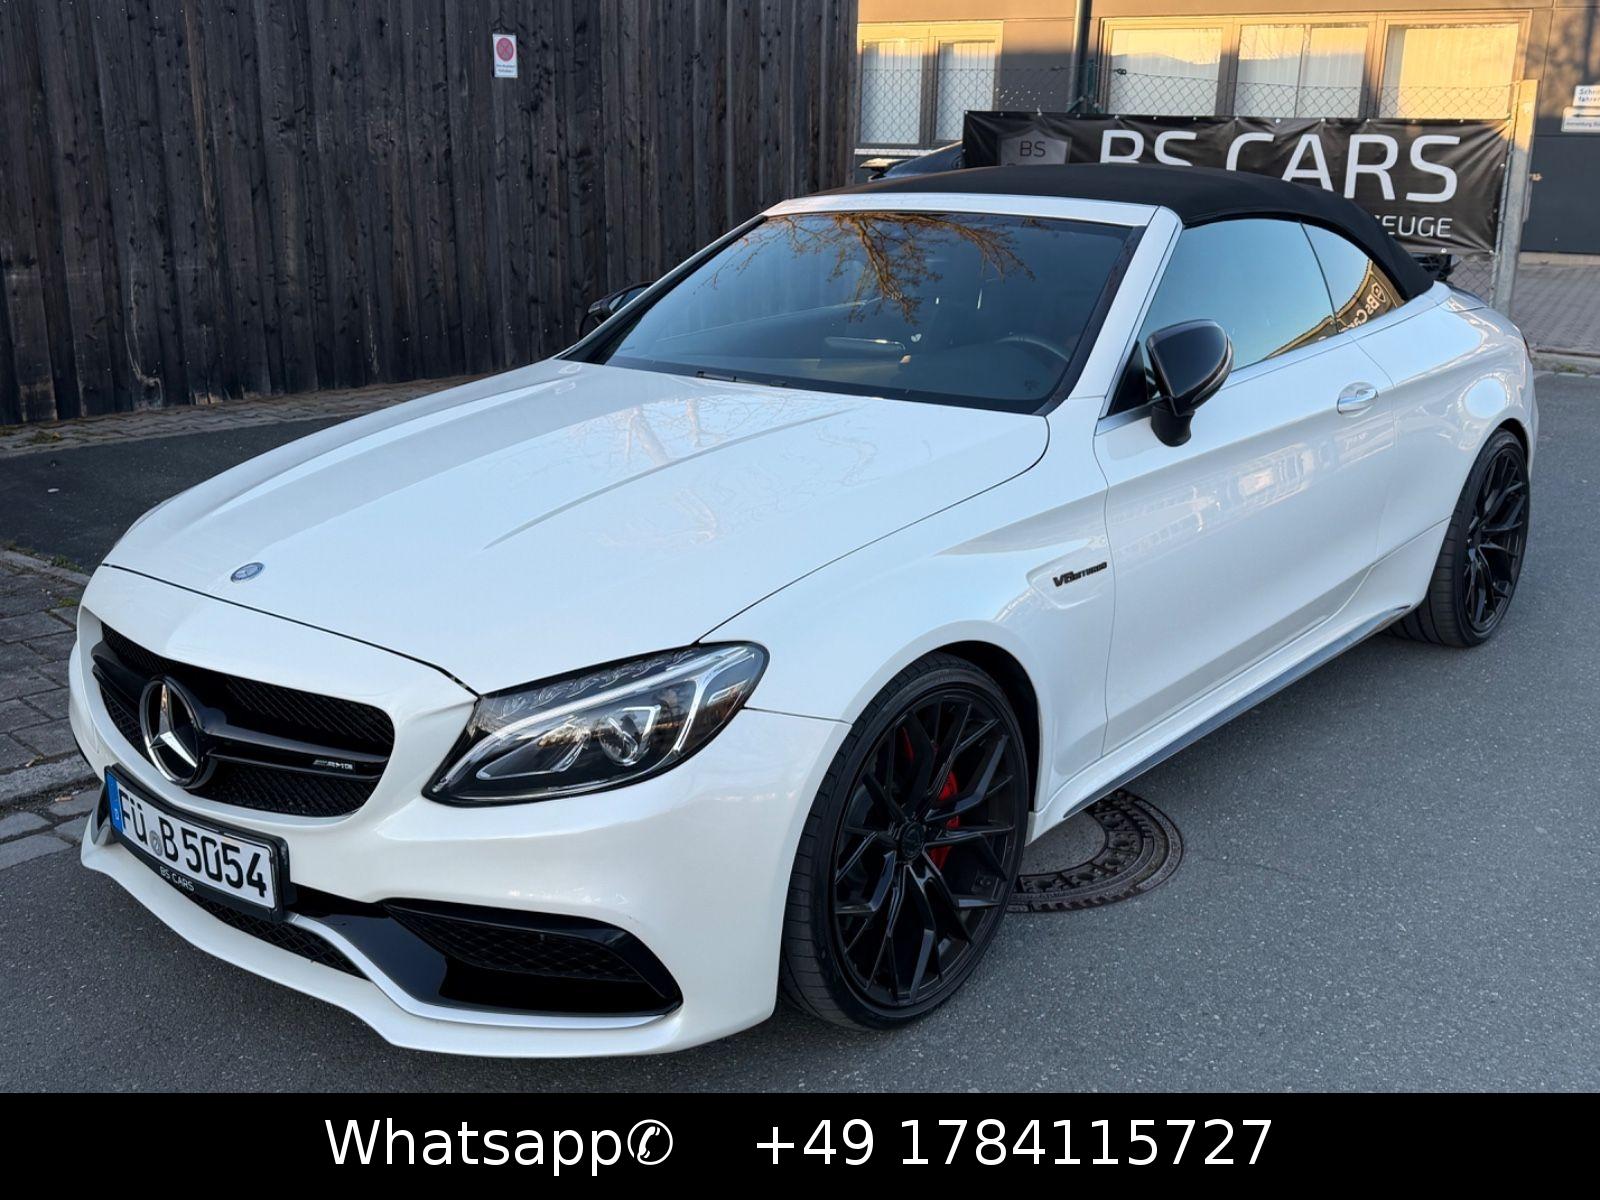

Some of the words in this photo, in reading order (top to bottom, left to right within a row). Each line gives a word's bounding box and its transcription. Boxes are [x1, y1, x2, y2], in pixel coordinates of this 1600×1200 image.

[1019, 139, 1046, 157] BS
[1226, 132, 1461, 203] CARS
[119, 788, 148, 846] FÜ
